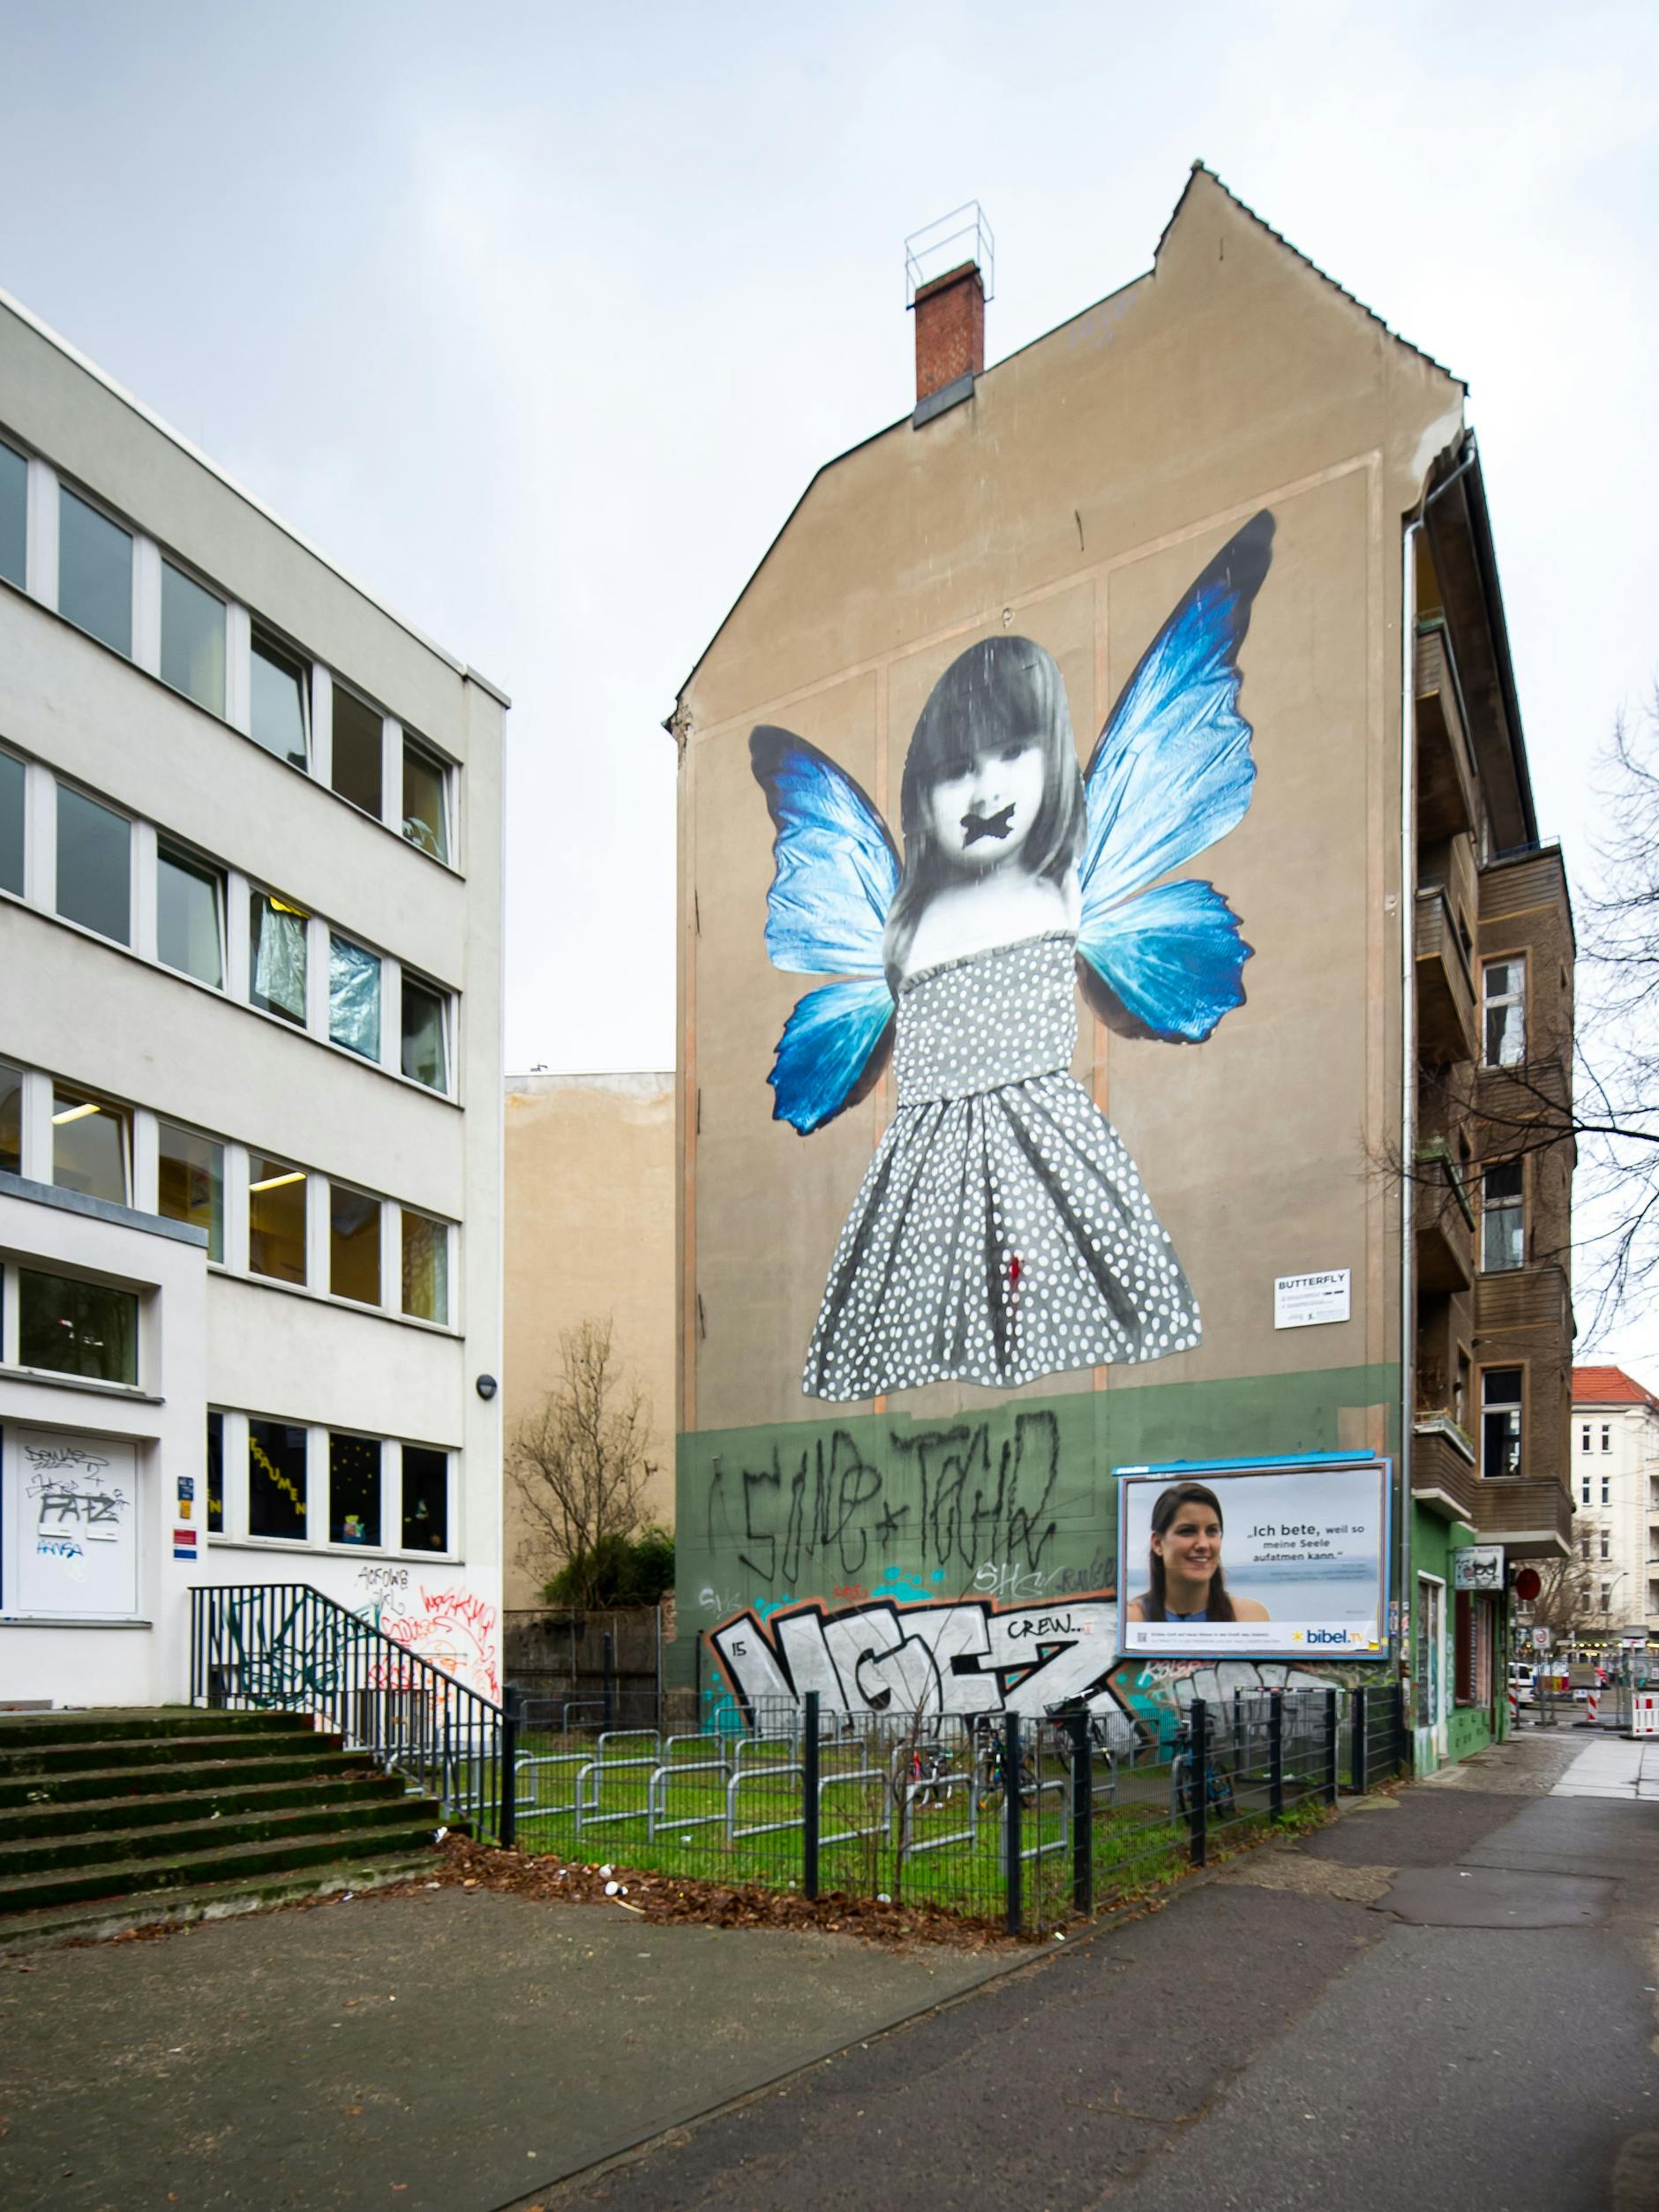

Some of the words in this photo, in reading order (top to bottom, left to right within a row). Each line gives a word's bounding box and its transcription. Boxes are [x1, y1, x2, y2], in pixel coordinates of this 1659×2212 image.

[1278, 1273, 1346, 1290] BUTTERFLY
[1280, 1524, 1320, 1537] bete,
[1325, 1525, 1348, 1534] weil
[1263, 1540, 1296, 1549] meine
[1300, 1539, 1331, 1548] Seele
[1253, 1552, 1304, 1563] aufatmen
[732, 1640, 747, 1657] 15
